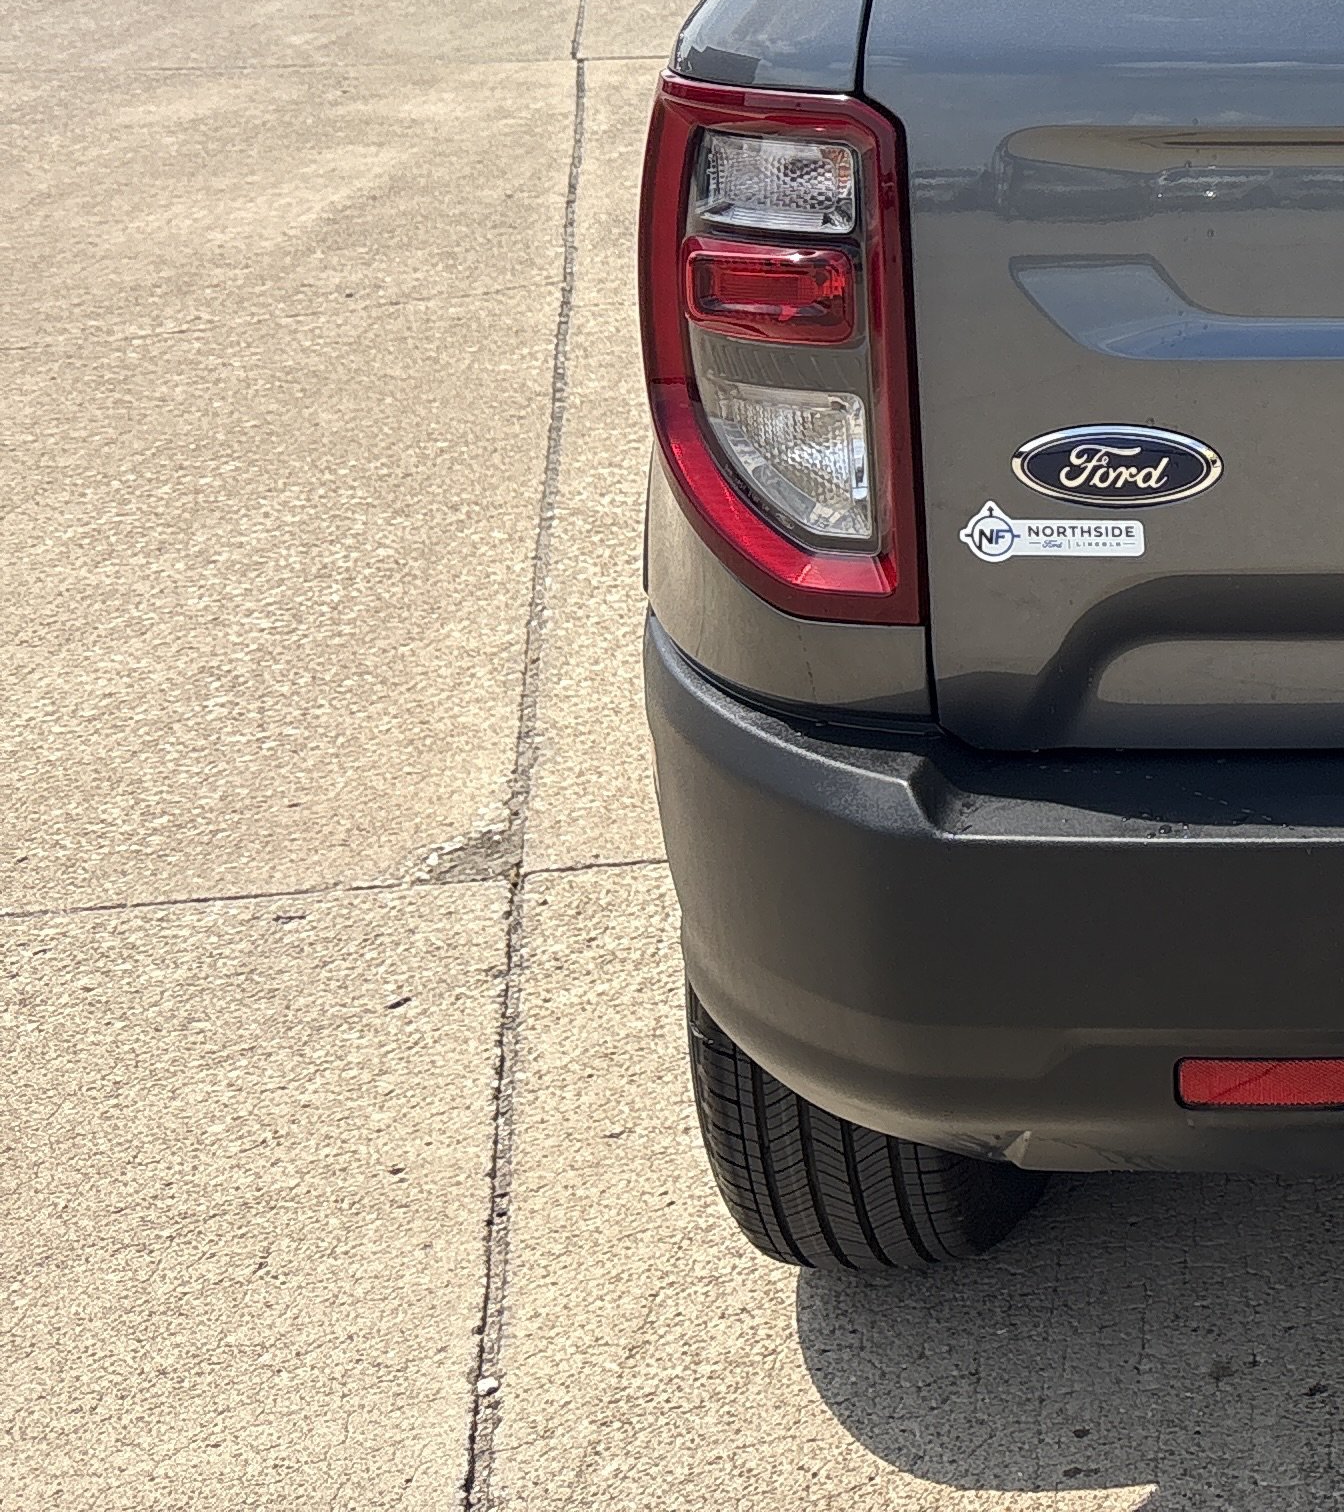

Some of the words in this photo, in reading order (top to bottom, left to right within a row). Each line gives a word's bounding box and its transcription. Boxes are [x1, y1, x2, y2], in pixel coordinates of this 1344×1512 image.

[1059, 444, 1170, 489] Ford
[978, 528, 1013, 551] NF
[1027, 525, 1136, 538] NORTHSIDE
[1041, 539, 1064, 549] Ford
